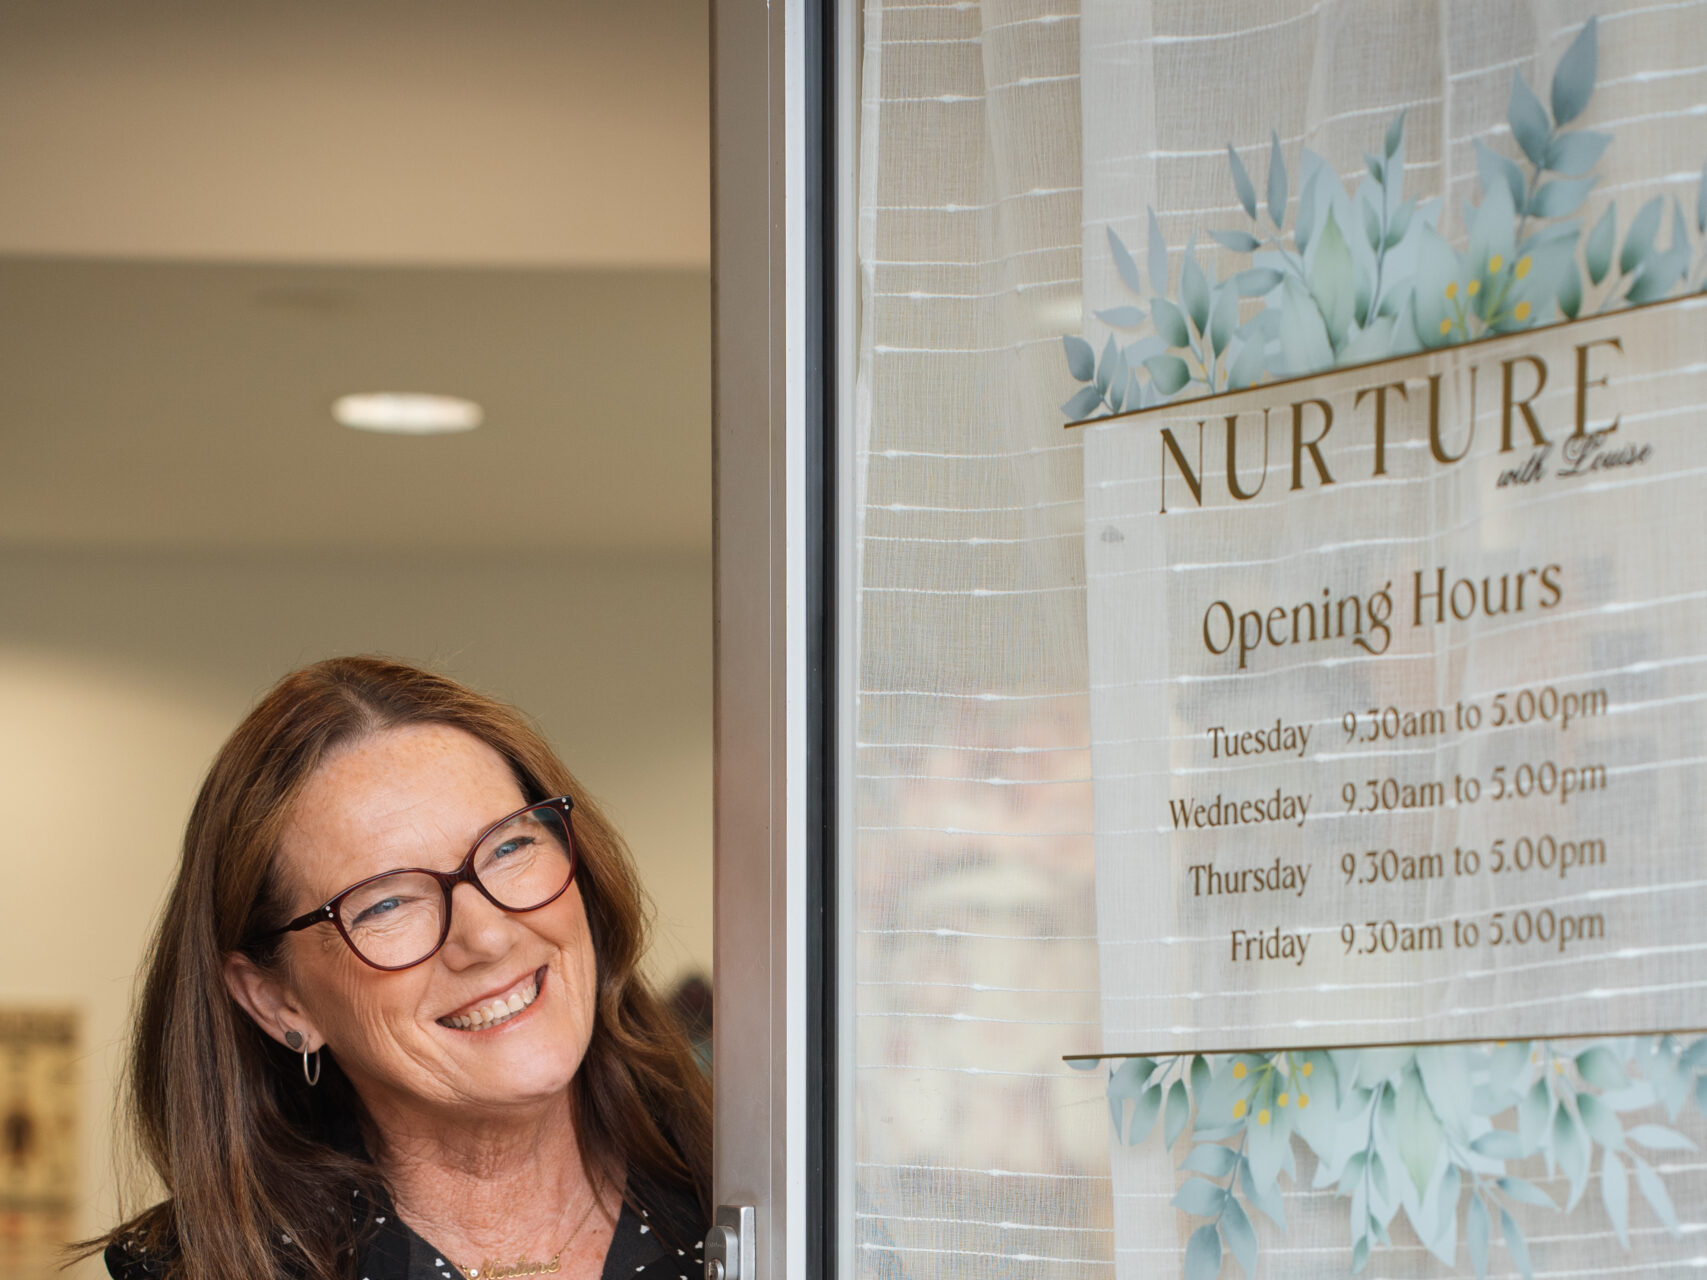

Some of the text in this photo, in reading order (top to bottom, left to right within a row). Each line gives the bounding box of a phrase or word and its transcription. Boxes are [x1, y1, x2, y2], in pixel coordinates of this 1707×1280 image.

[1159, 337, 1624, 513] NURTURE
[1497, 432, 1652, 488] with Louise
[1203, 563, 1563, 669] Opening Hours
[1207, 686, 1608, 758] Tuesday 9.30am to 5.00pm
[1169, 761, 1608, 829] Wednesday 9.30am to 5.00pm
[1189, 834, 1607, 897] Thursday 9.30am to 5.00pm
[1230, 908, 1606, 966] Friday 9.30am to 5.00pm
